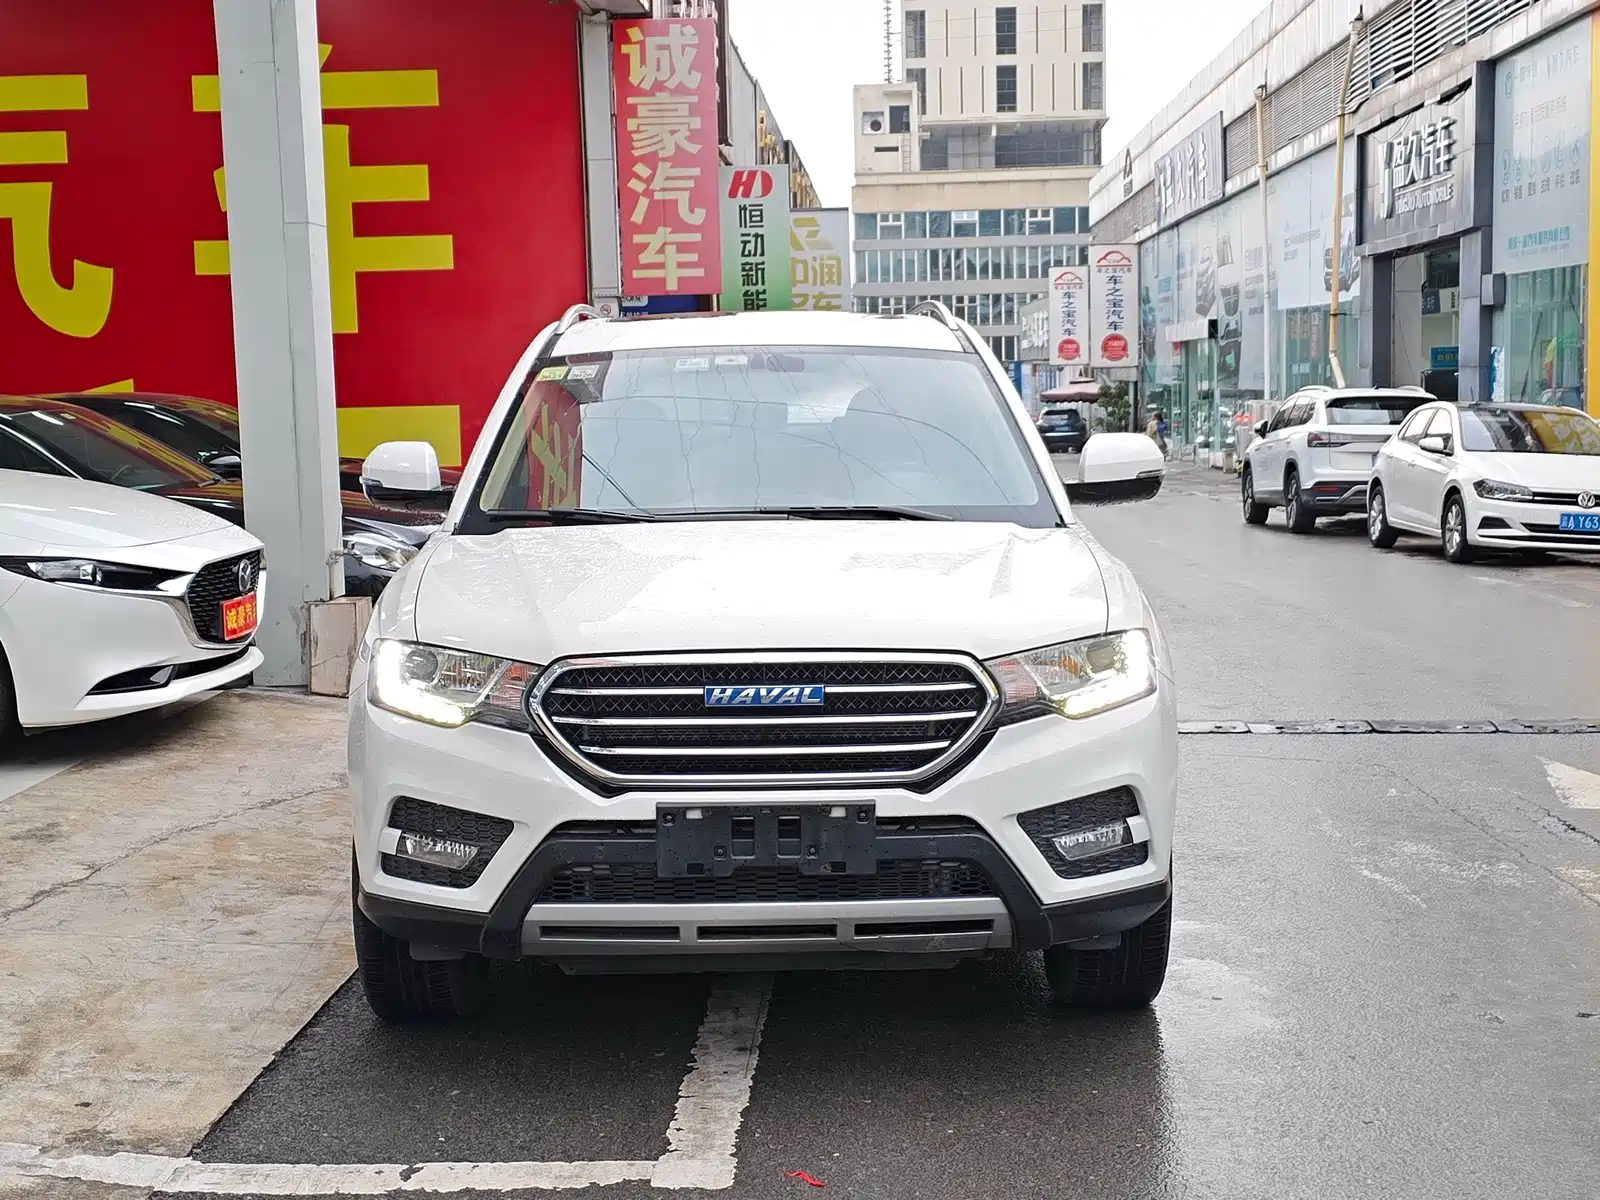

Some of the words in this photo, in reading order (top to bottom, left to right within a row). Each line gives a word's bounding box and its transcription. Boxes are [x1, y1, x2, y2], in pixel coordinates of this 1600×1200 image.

[620, 23, 707, 291] 诚豪汽车
[728, 169, 773, 199] HD
[738, 202, 768, 311] 恒动新能
[1061, 291, 1077, 337] 车之宝汽车
[1105, 274, 1124, 332] 车之宝汽车
[708, 687, 821, 705] HAVAL
